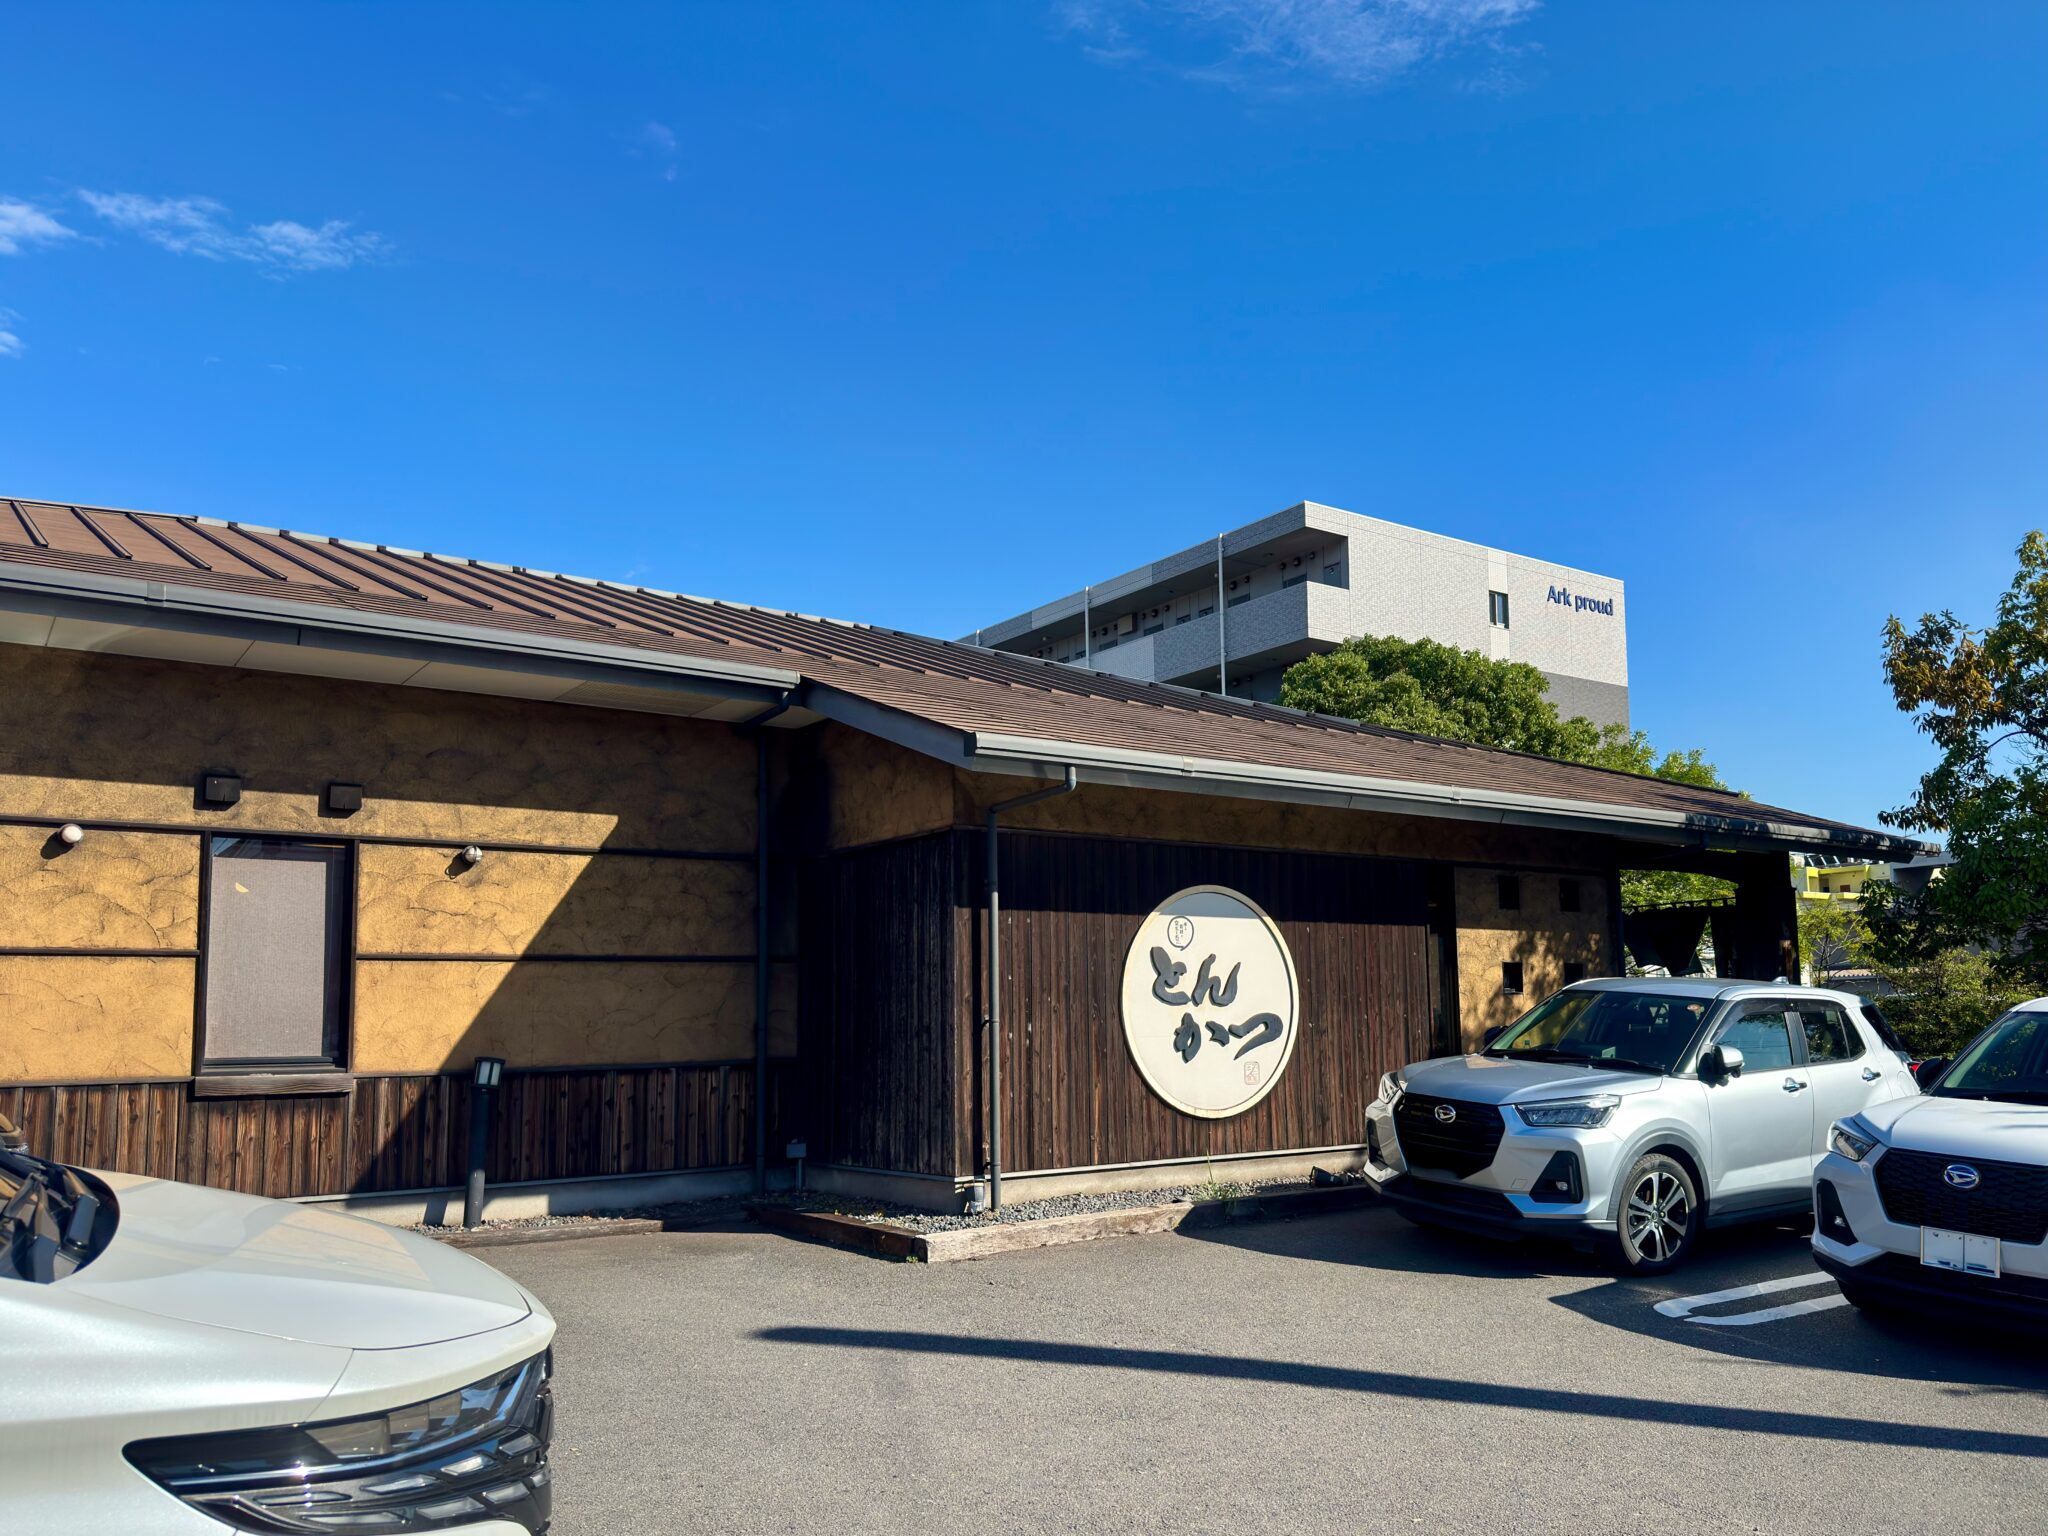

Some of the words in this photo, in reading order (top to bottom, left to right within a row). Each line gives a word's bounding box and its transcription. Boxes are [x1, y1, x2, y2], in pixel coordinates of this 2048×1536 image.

[1547, 585, 1572, 607] Ark
[1575, 595, 1614, 616] proud
[1150, 946, 1241, 1007] とん
[1173, 1012, 1284, 1064] かつ
